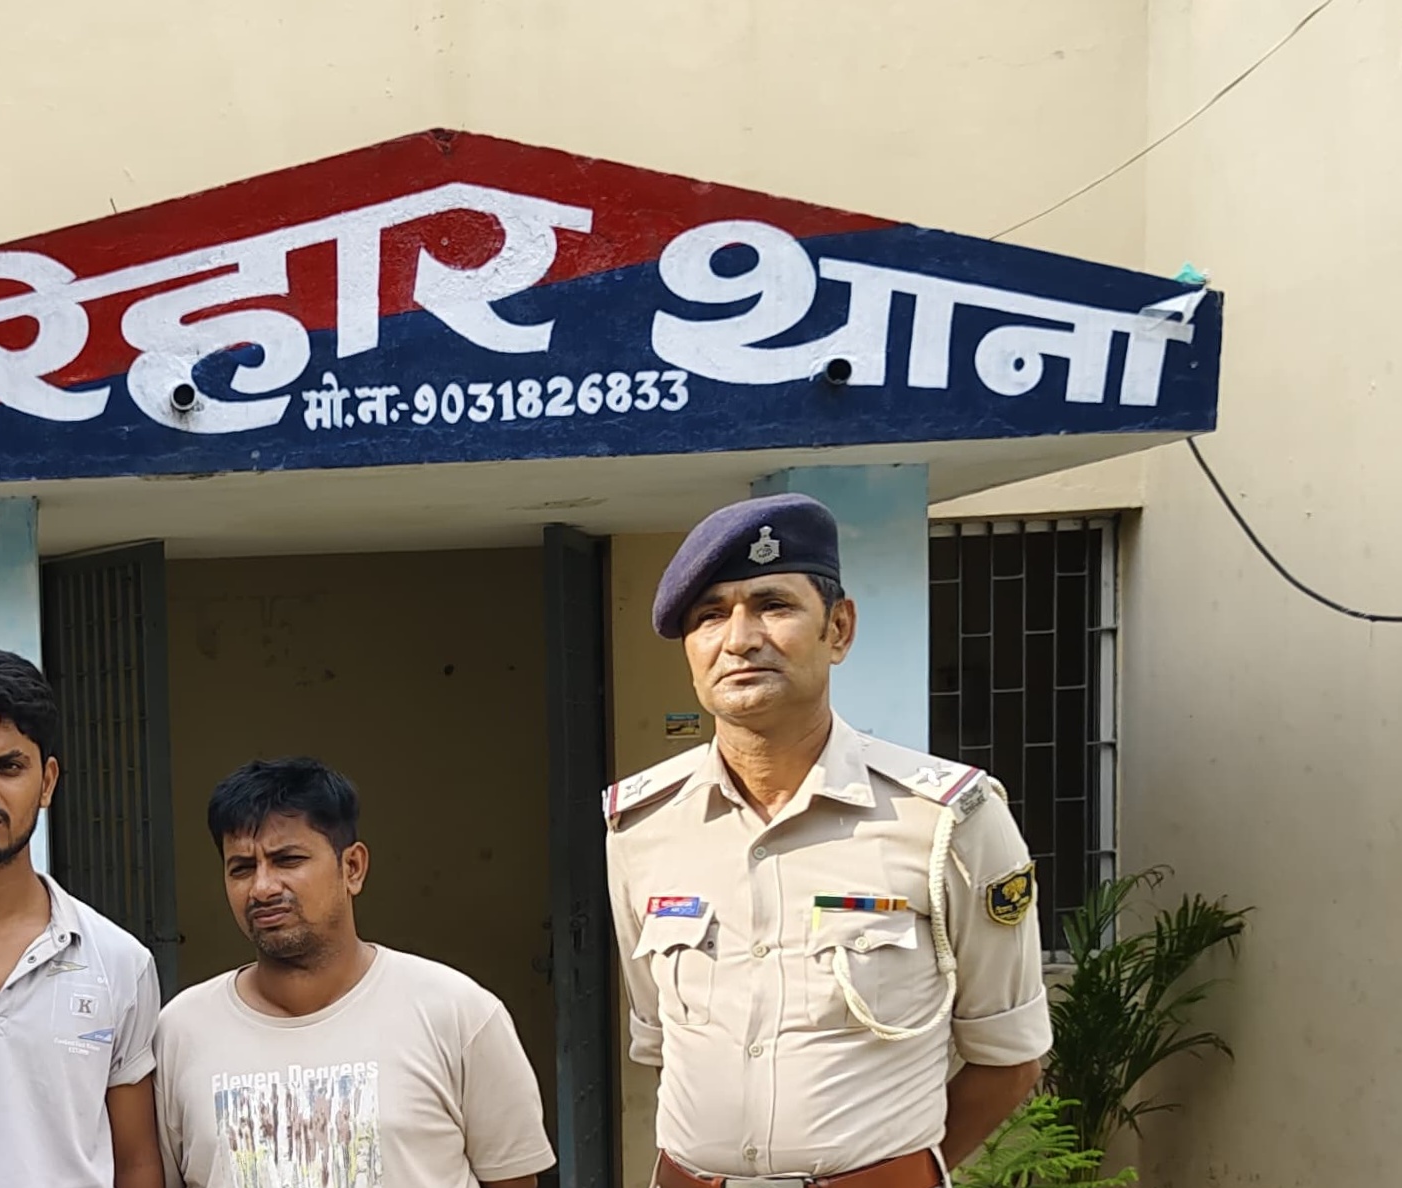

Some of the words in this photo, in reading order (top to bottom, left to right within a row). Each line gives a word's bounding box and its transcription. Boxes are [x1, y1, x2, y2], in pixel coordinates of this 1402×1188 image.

[651, 220, 1195, 406] थाना
[78, 998, 92, 1014] K
[211, 1071, 281, 1094] Eleven
[287, 1060, 380, 1090] Degrees
